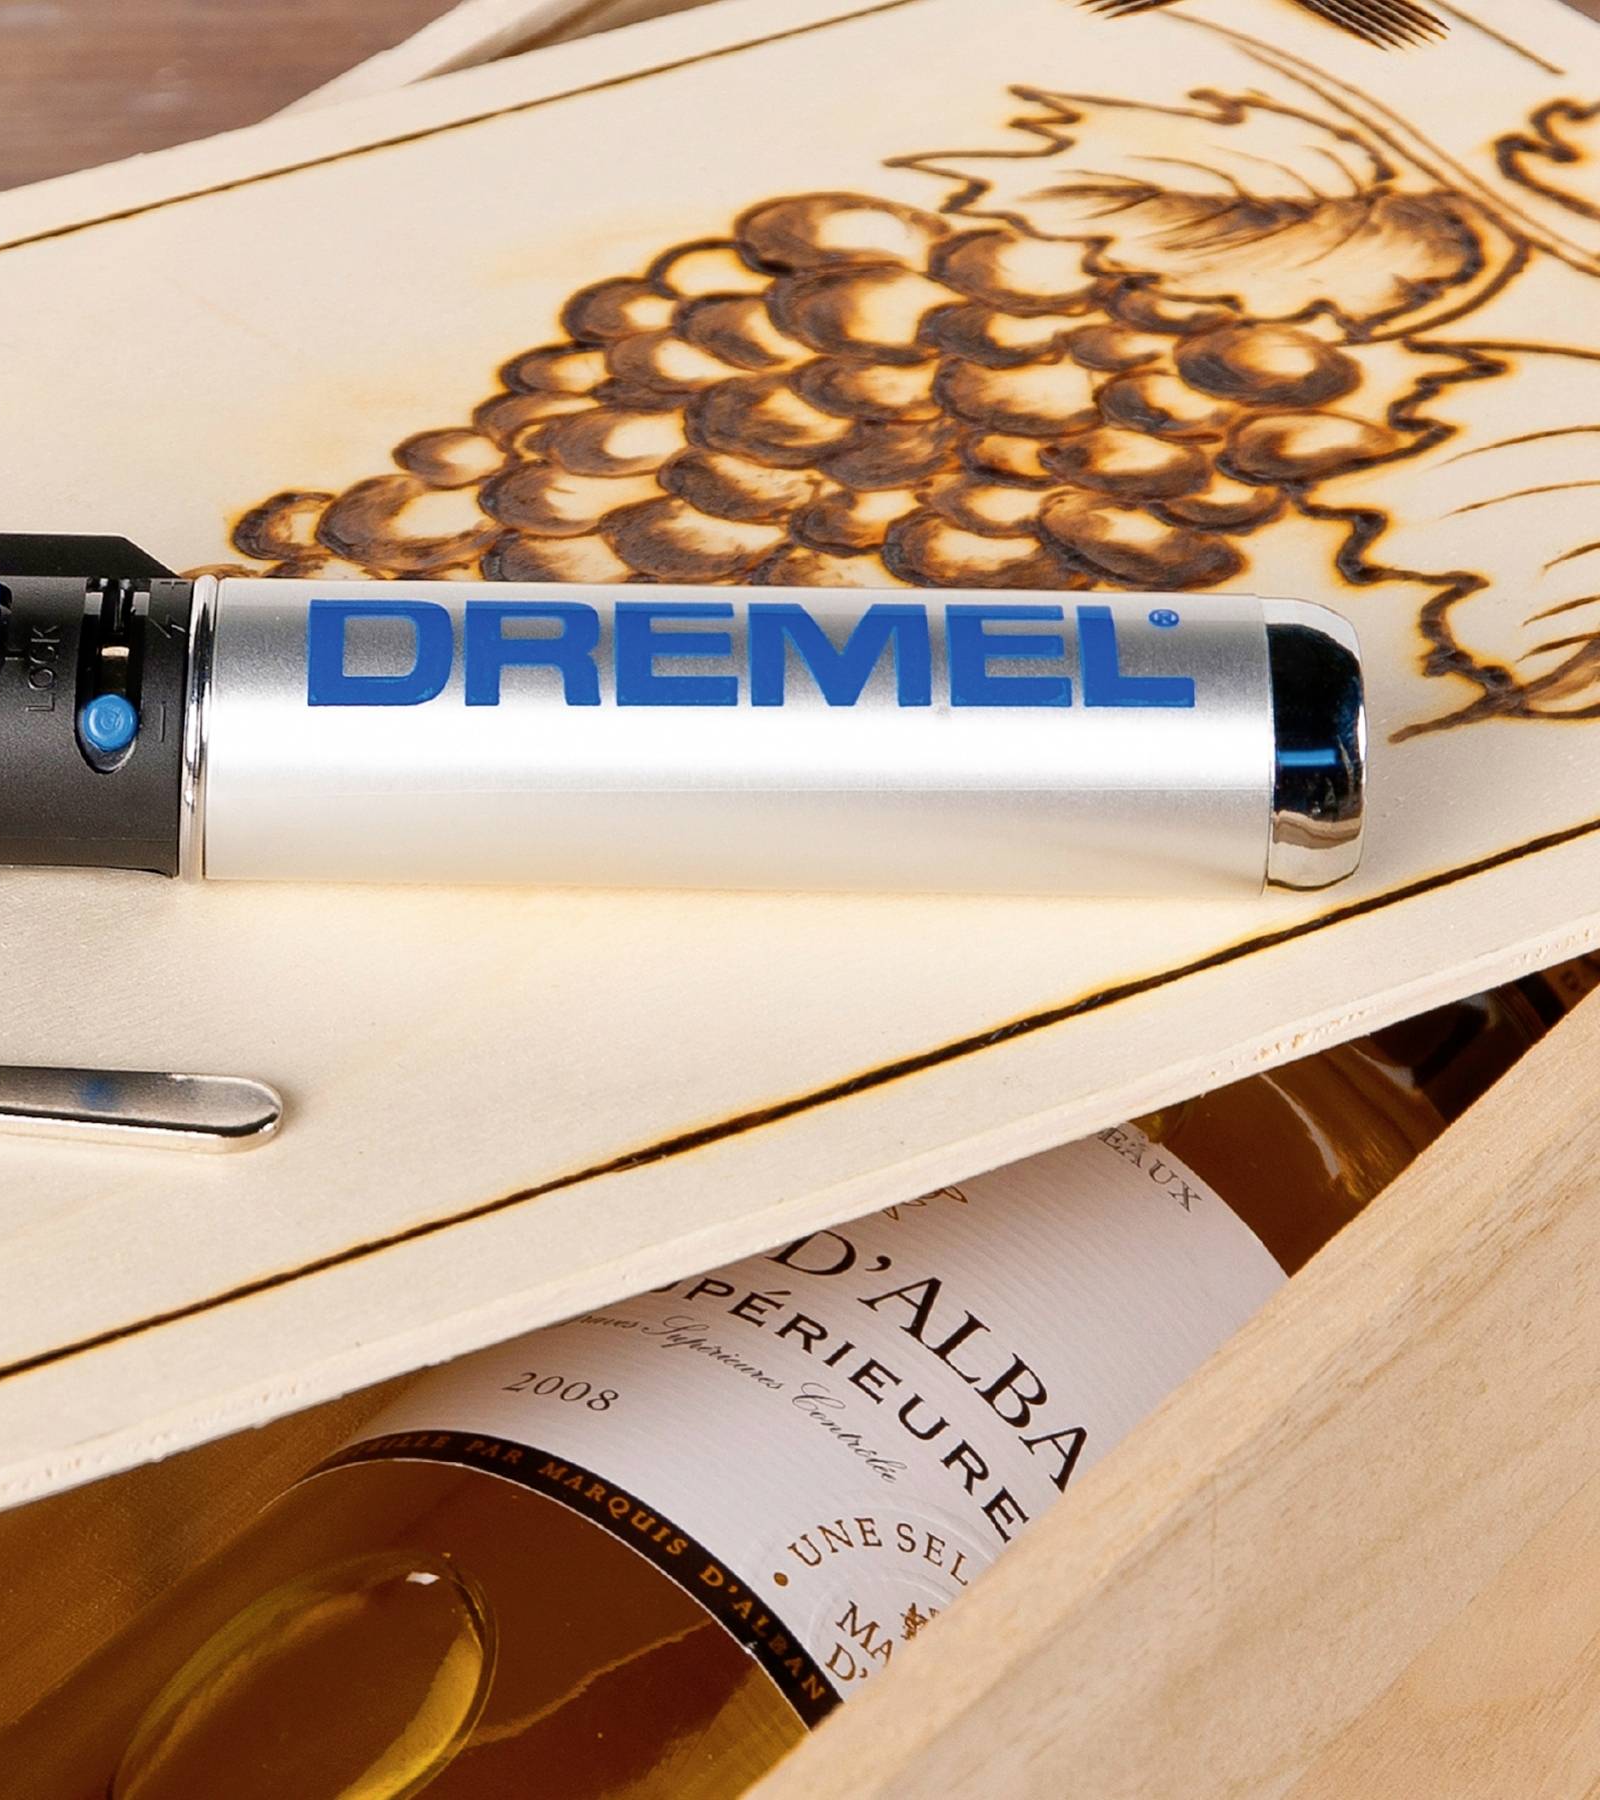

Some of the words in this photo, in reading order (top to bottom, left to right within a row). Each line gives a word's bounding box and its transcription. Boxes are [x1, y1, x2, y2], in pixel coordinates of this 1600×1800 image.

[25, 625, 61, 712] LOCK
[503, 1371, 620, 1412] 2008
[651, 1278, 1030, 1543] PÉRIEURE
[464, 1439, 524, 1464] PAR
[538, 1461, 688, 1555] MARQUIS
[699, 1564, 826, 1700] D'ALBAN
[787, 1517, 882, 1566] UNE
